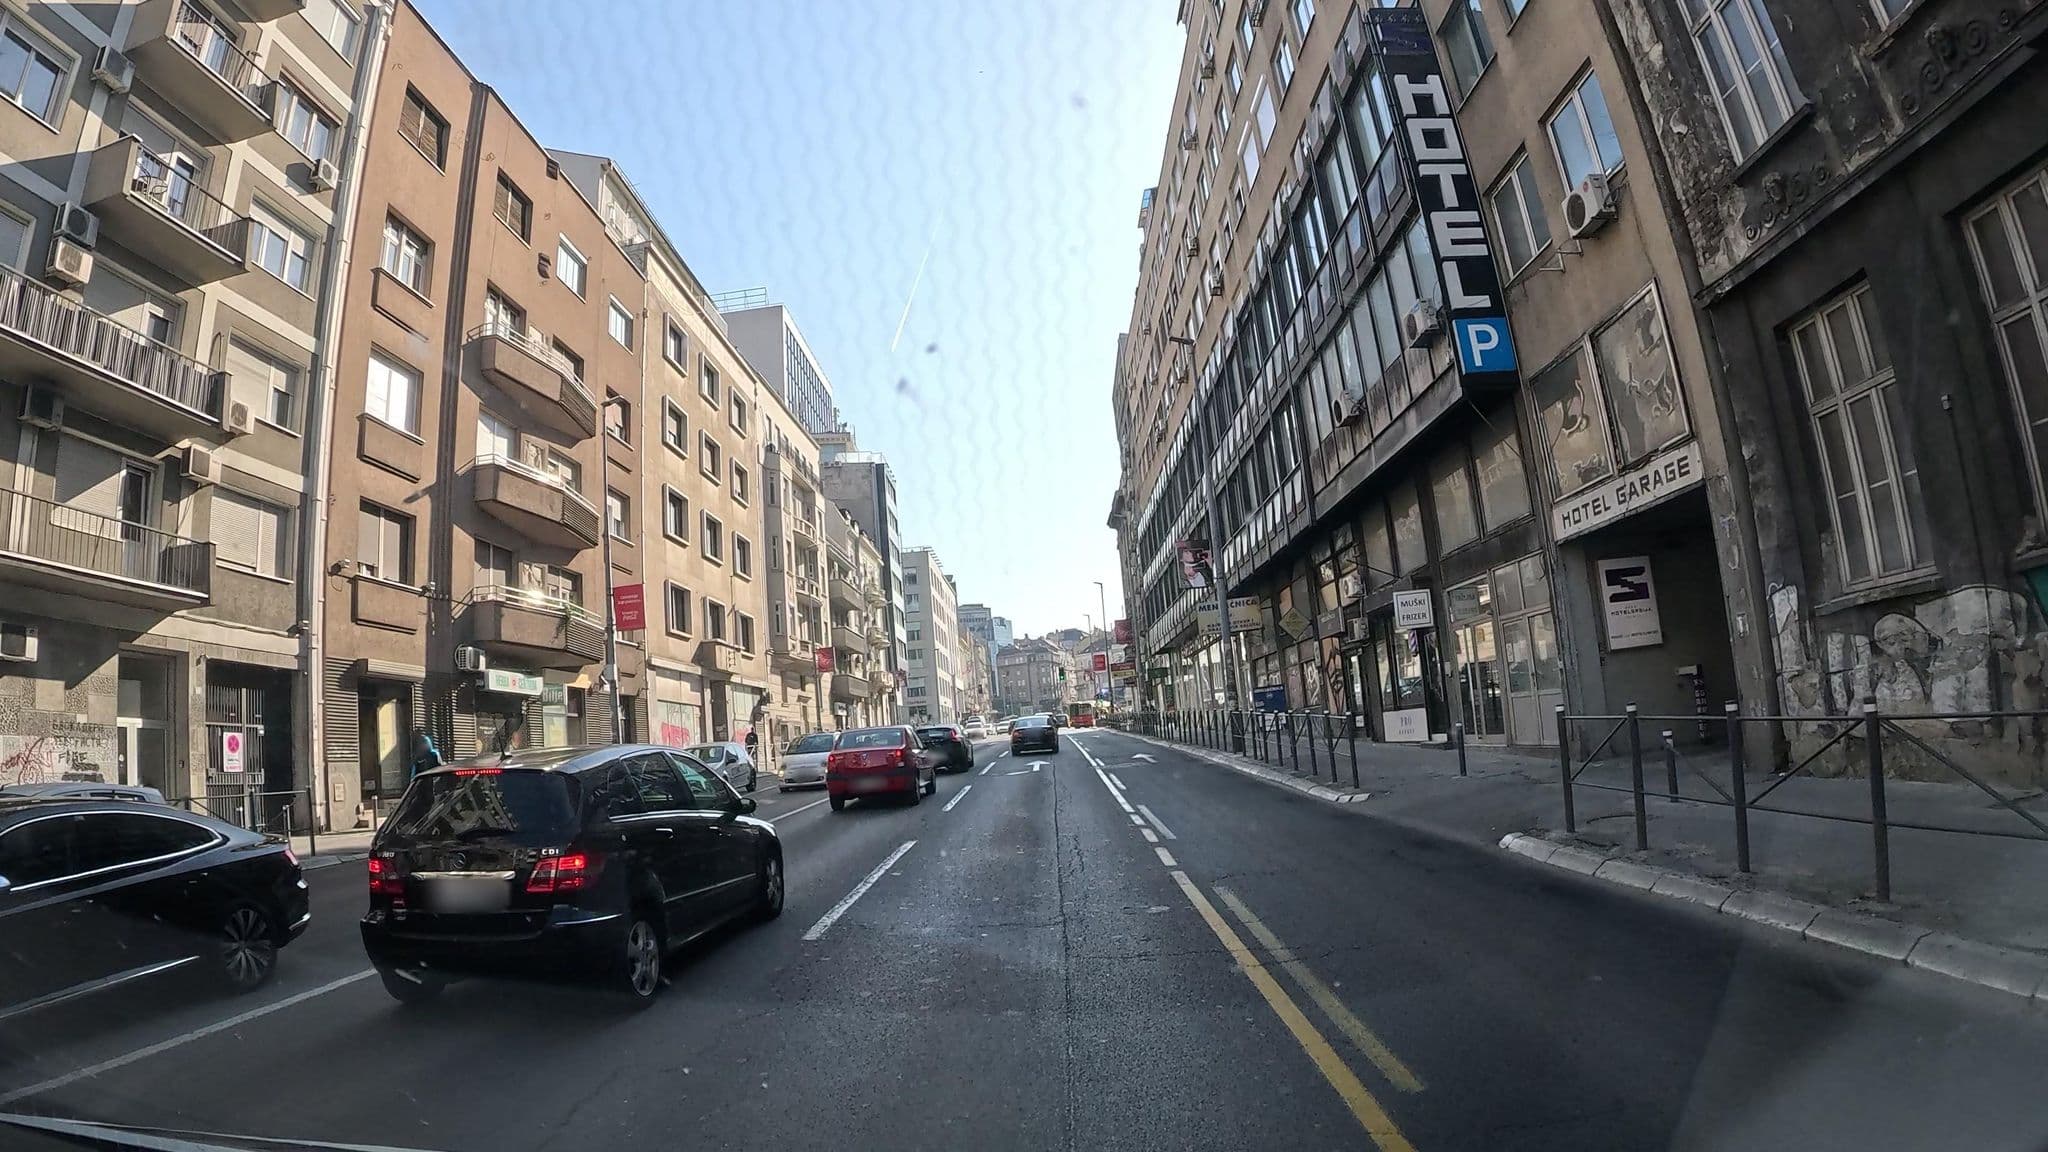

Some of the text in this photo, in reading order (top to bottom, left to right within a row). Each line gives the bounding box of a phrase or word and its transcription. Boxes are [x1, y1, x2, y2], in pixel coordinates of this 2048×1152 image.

[1393, 74, 1492, 309] HOTEL
[1467, 323, 1499, 367] P
[1561, 455, 1691, 530] HOTEL GARAGE
[1400, 598, 1426, 608] MUŠKI
[1402, 612, 1427, 621] FRIZER
